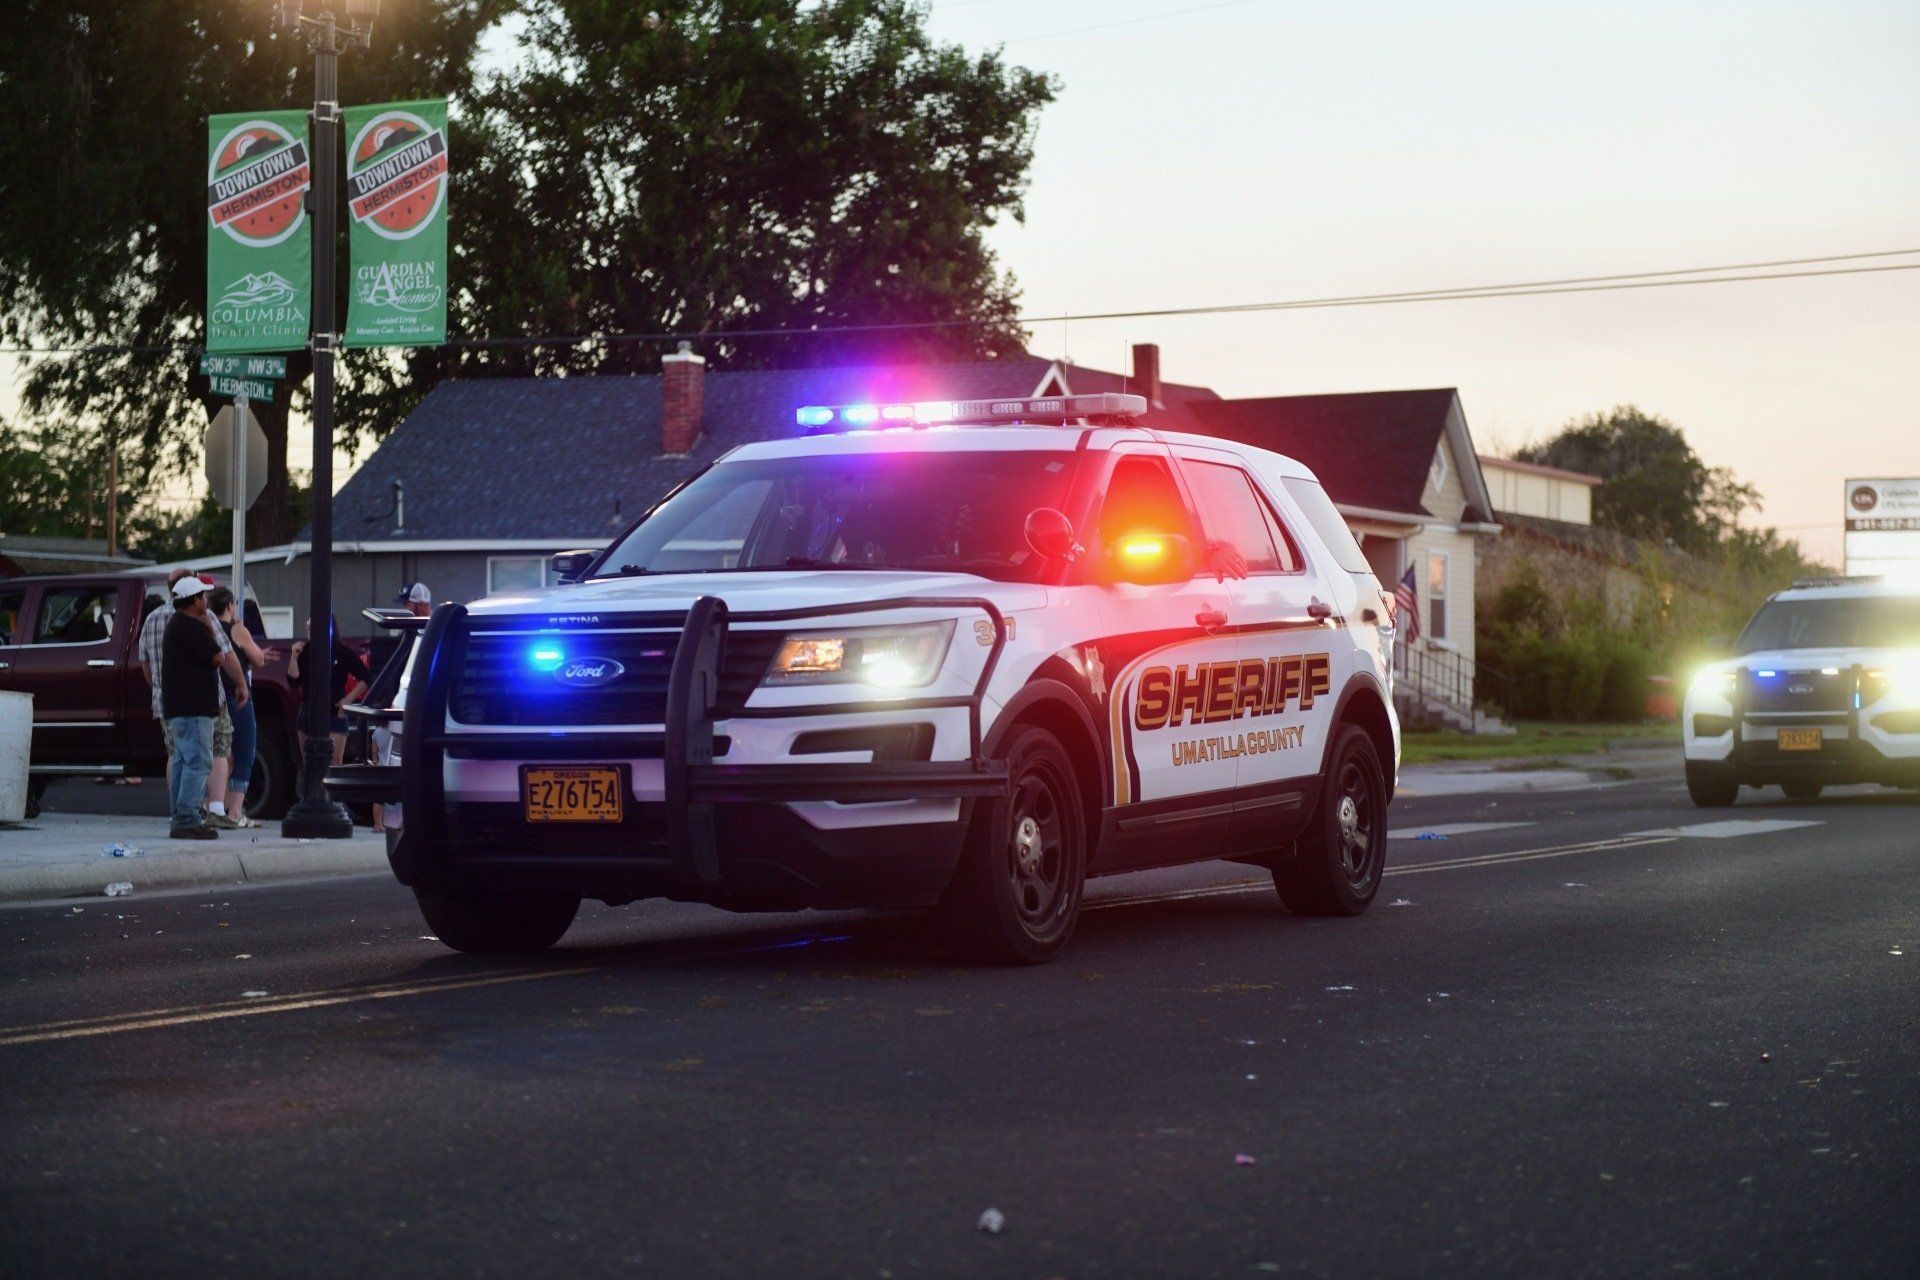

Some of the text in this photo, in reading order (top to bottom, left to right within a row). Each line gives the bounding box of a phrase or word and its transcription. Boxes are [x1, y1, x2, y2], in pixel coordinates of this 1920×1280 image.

[214, 150, 296, 201] DOWNTOWN
[355, 140, 433, 195] DOWNTOWN
[219, 172, 303, 219] HERMISTON
[362, 161, 440, 213] HERMISTON
[212, 307, 305, 324] COLUMBIA
[262, 324, 304, 336] Clinic
[208, 357, 224, 373] SW
[248, 359, 265, 374] NW
[209, 375, 265, 399] W HERMISTON
[565, 663, 606, 678] Ford
[1135, 652, 1331, 731] SHERIFF
[553, 770, 591, 779] OREGON
[528, 779, 617, 809] E276754
